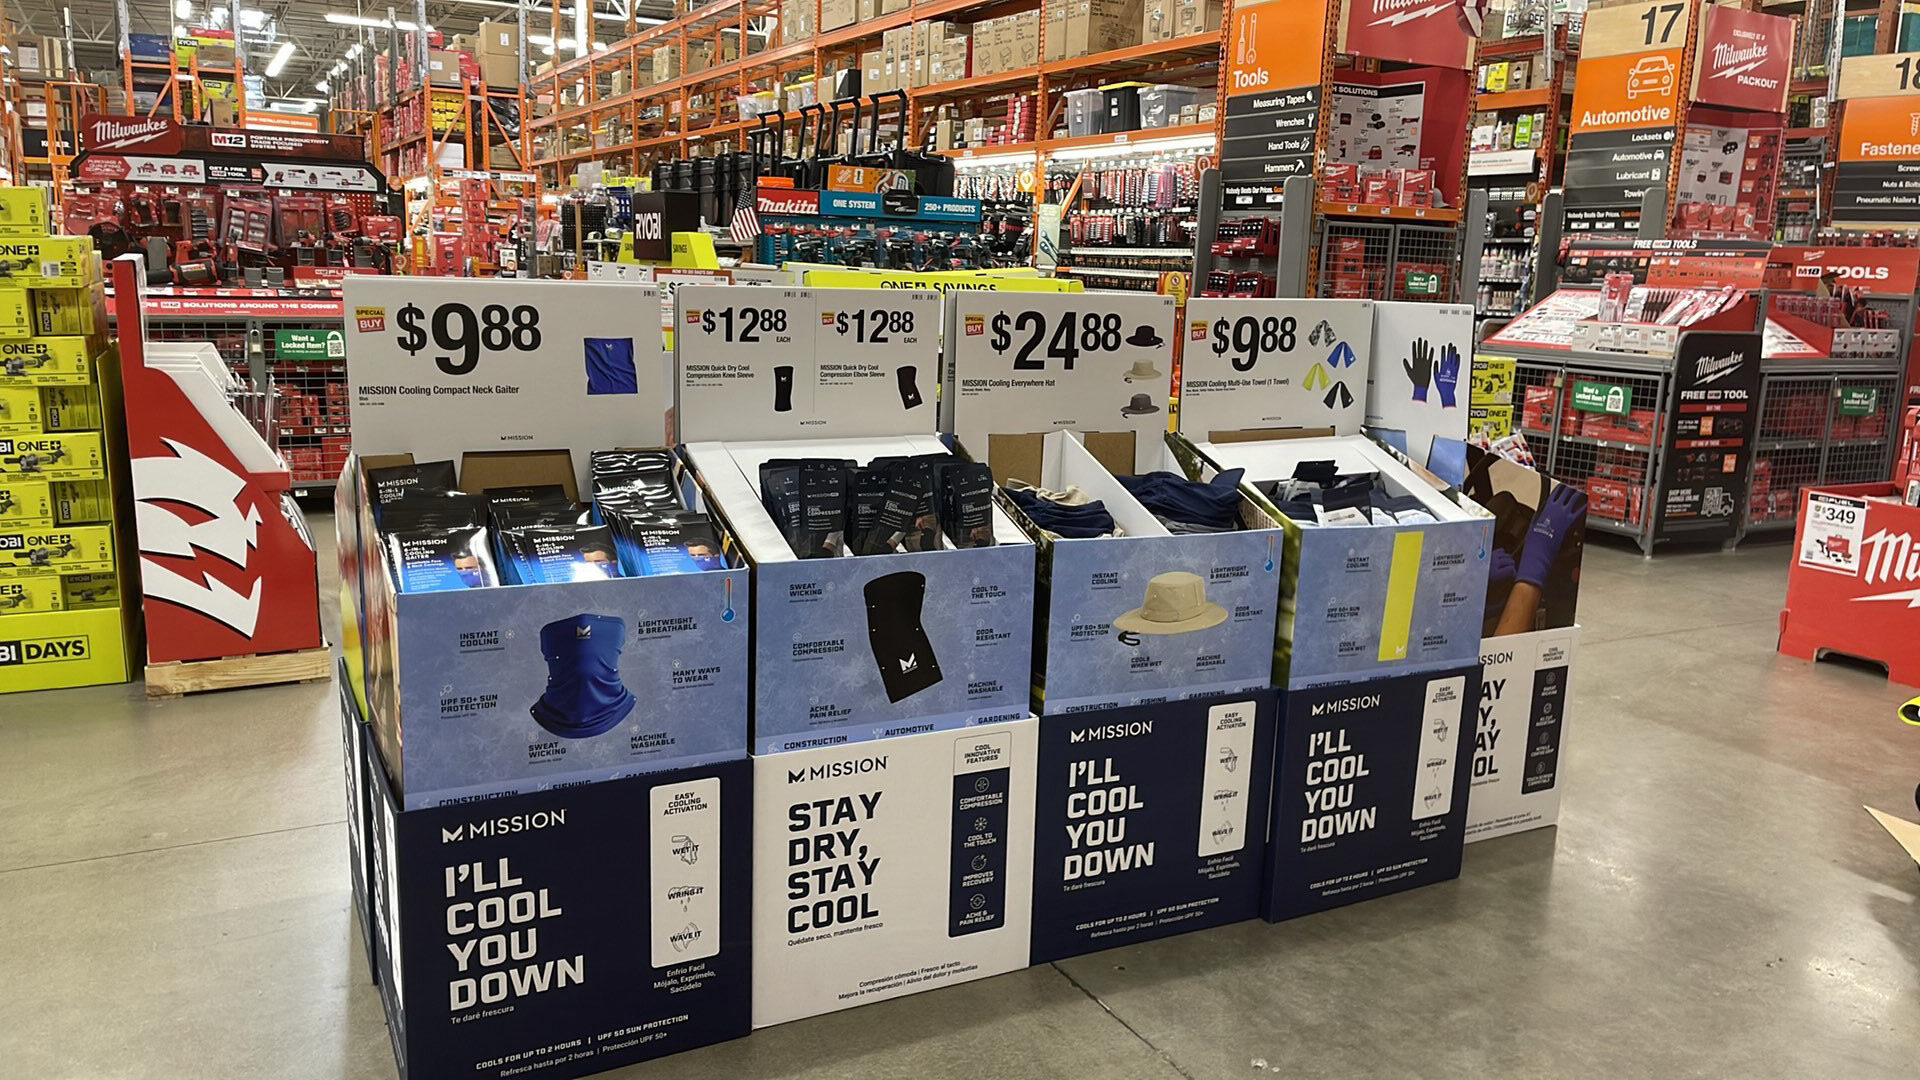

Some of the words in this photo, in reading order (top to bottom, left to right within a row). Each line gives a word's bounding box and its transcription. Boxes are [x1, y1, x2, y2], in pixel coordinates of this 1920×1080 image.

[1641, 3, 1683, 45] 17
[1712, 42, 1768, 70] Milwaukee
[1233, 67, 1269, 88] Tools
[1737, 75, 1778, 89] PACKOUT
[1338, 86, 1378, 97] SOLUTIONS
[1253, 97, 1285, 108] Measuring
[1286, 95, 1305, 106] Tapes
[1581, 107, 1671, 127] Automotive
[1276, 118, 1305, 128] Wrenches
[90, 119, 168, 143] Milwaukee
[213, 135, 245, 146] M12
[284, 137, 329, 145] PRODUCTIVITY
[1631, 132, 1662, 142] Locksets
[1268, 142, 1284, 151] Hand
[1285, 140, 1300, 150] Tools
[1612, 152, 1652, 162] Automotive
[1264, 164, 1294, 173] Hammers
[1616, 171, 1650, 180] Lubricant
[833, 199, 852, 209] ONE
[854, 200, 876, 210] SYSTEM
[1856, 196, 1891, 204] Pneumatic
[1893, 195, 1916, 204] Nailers
[757, 198, 819, 215] Makita
[924, 202, 941, 212] 250+
[943, 203, 976, 214] PRODUCTS
[635, 213, 662, 240] RYOBI
[1797, 267, 1821, 277] M18
[1826, 267, 1889, 279] TOOLS
[356, 308, 385, 317] SPECIAL
[360, 319, 382, 330] BUY
[965, 315, 984, 323] SPECIAL
[967, 324, 983, 333] BUY
[1192, 330, 1206, 338] BUY
[281, 341, 305, 349] Locked
[307, 341, 326, 349] Item?
[686, 364, 710, 372] MISSION
[711, 364, 727, 372] Quick
[728, 364, 737, 373] Dry
[841, 364, 856, 372] Quick
[857, 364, 867, 372] Dry
[1696, 350, 1744, 378] Milwaukee
[686, 371, 721, 379] Compression
[820, 371, 852, 379] Compression
[962, 379, 988, 387] MISSION
[988, 379, 1010, 388] Cooling
[1011, 379, 1044, 388] Everywhere
[1045, 379, 1055, 387] Hat
[1186, 380, 1208, 388] MISSION
[1208, 380, 1227, 388] Cooling
[1227, 379, 1251, 387] Multi-Use
[1273, 378, 1290, 386] Towel)
[359, 386, 397, 395] MISSION
[399, 385, 431, 396] Cooling
[433, 385, 470, 396] Compact
[472, 385, 494, 394] Neck
[495, 385, 519, 394] Gaiter
[1680, 391, 1706, 400] FREE
[1723, 390, 1748, 400] TOOL
[17, 440, 61, 452] ONE+
[386, 478, 418, 487] MISSION
[27, 534, 71, 546] ONE+
[412, 538, 447, 546] MISSION
[543, 535, 575, 543] MISSION
[789, 583, 816, 591] SWEAT
[790, 589, 822, 597] WICKING
[638, 617, 693, 628] LIGHTWEIGHT
[646, 623, 697, 634] BREATHABLE
[460, 631, 499, 640] INSTANT
[976, 632, 1011, 641] RESISTANT
[460, 638, 499, 648] COOLING
[792, 639, 844, 650] COMFORTABLE
[25, 639, 85, 660] DAYS
[792, 646, 844, 656] COMPRESSION
[673, 669, 695, 678] MANY
[697, 666, 721, 675] WAYS
[968, 680, 997, 689] MACHINE
[968, 685, 1003, 695] WASHABLE
[441, 702, 497, 714] PROTECTION
[1066, 701, 1118, 713] CONSTRUCTION
[1326, 694, 1381, 715] MISSION
[978, 713, 1021, 724] GARDENING
[885, 723, 935, 737] AUTOMOTIVE
[1089, 720, 1154, 741] MISSION
[631, 733, 668, 744] MACHINE
[631, 738, 675, 750] WASHABLE
[784, 735, 847, 750] CONSTRUCTION
[1308, 728, 1352, 757] I'LL
[529, 742, 559, 752] SWEAT
[529, 748, 566, 759] WICKING
[811, 755, 888, 781] MISSION
[1069, 757, 1120, 788] I'LL
[1306, 753, 1370, 786] COOL
[675, 792, 695, 801] EASY
[1067, 785, 1144, 819] COOL
[1304, 784, 1354, 814] YOU
[668, 798, 701, 809] COOLING
[664, 803, 708, 816] ACTIVATION
[788, 791, 883, 832] STAY
[469, 809, 567, 840] MISSION
[1301, 806, 1377, 843] DOWN
[1066, 817, 1126, 850] YOU
[788, 829, 868, 867] DRY,
[1063, 841, 1156, 881] DOWN
[445, 857, 523, 898] I'LL
[788, 857, 881, 900] STAY
[446, 888, 563, 936] COOL
[788, 893, 880, 934] COOL
[788, 936, 815, 948] Quédate
[816, 932, 832, 942] seco,
[834, 926, 863, 938] mantente
[864, 921, 884, 933] fresco
[446, 927, 537, 972] YOU
[450, 954, 585, 1011] DOWN
[451, 1015, 460, 1024] Te
[462, 1011, 480, 1021] daré
[482, 1003, 514, 1018] frescura
[476, 1057, 503, 1070] COOLS
[505, 1052, 521, 1063] FOR
[523, 1050, 534, 1060] UP
[536, 1047, 546, 1056] TO
[555, 1039, 582, 1051] HOURS
[598, 1031, 613, 1042] UPF
[614, 1029, 625, 1038] 50
[626, 1025, 642, 1035] SUN
[643, 1014, 689, 1031] PROTECTION
